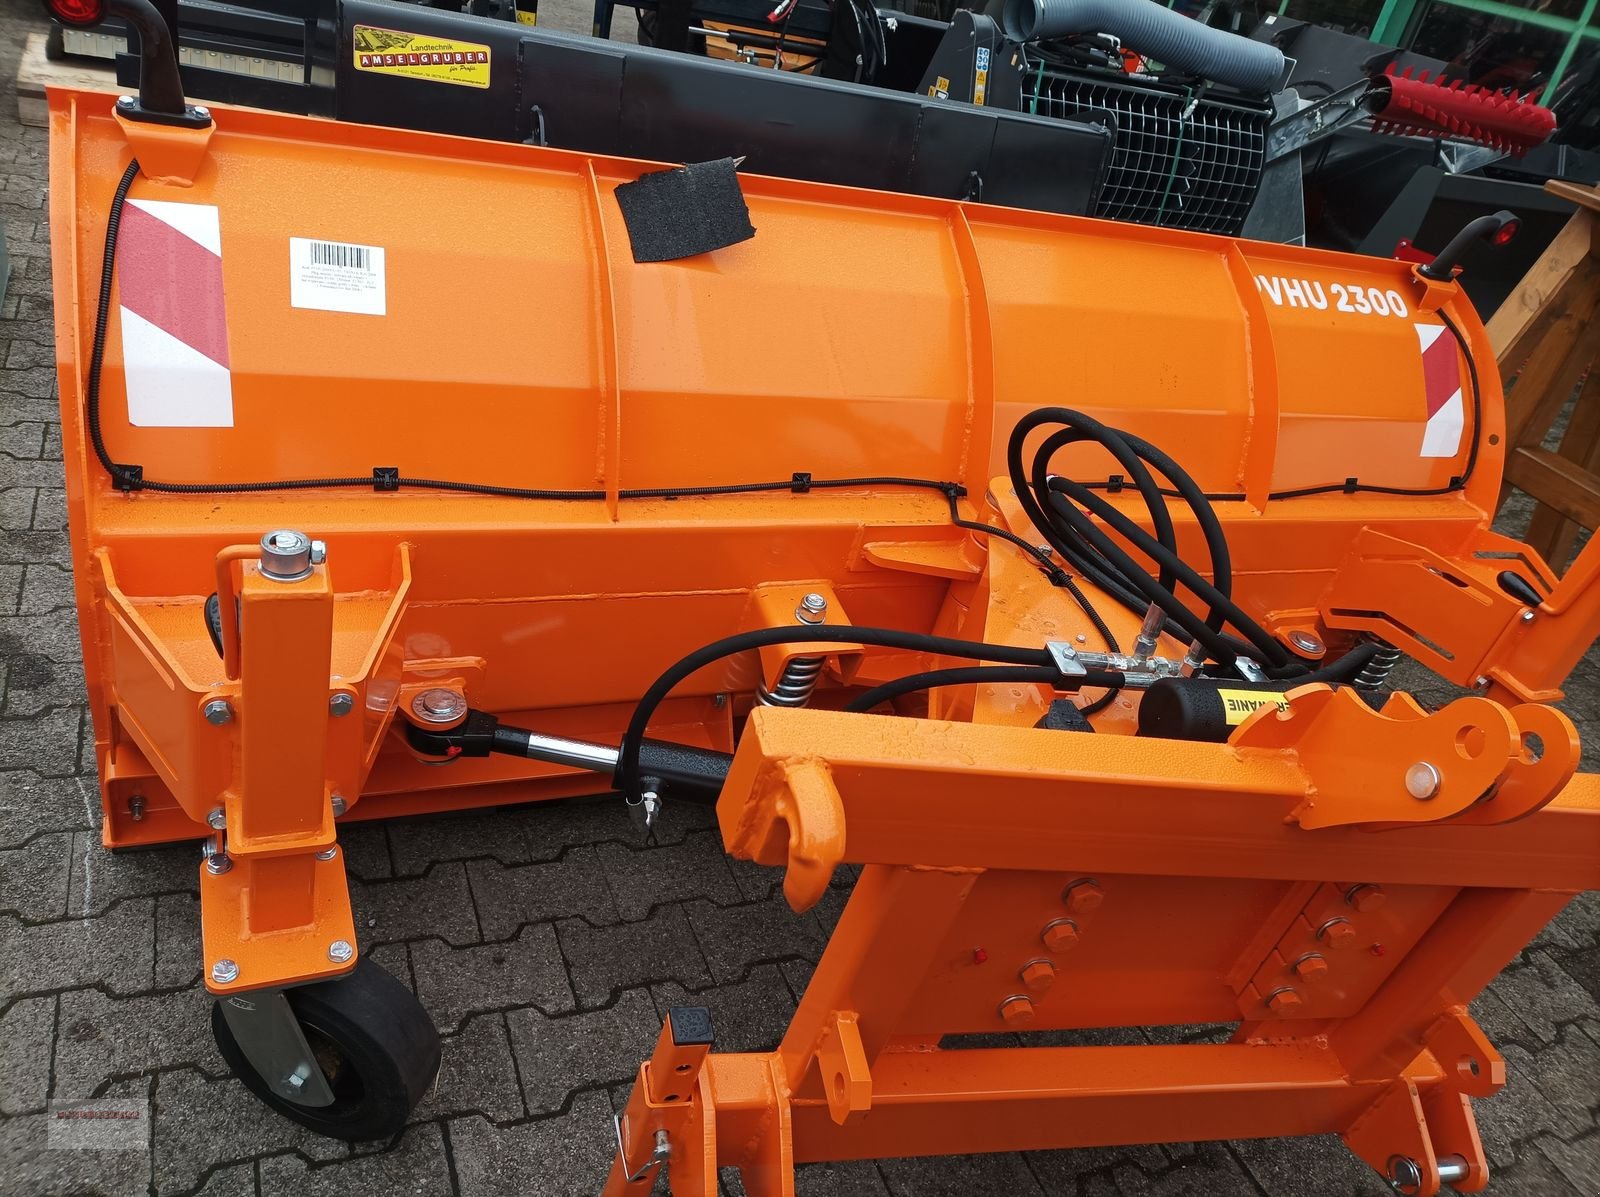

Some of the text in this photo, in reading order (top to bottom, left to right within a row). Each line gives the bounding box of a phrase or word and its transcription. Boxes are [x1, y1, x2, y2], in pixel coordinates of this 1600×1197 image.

[361, 52, 486, 65] AMSELGRUBER
[1254, 275, 1408, 318] VHU 2300
